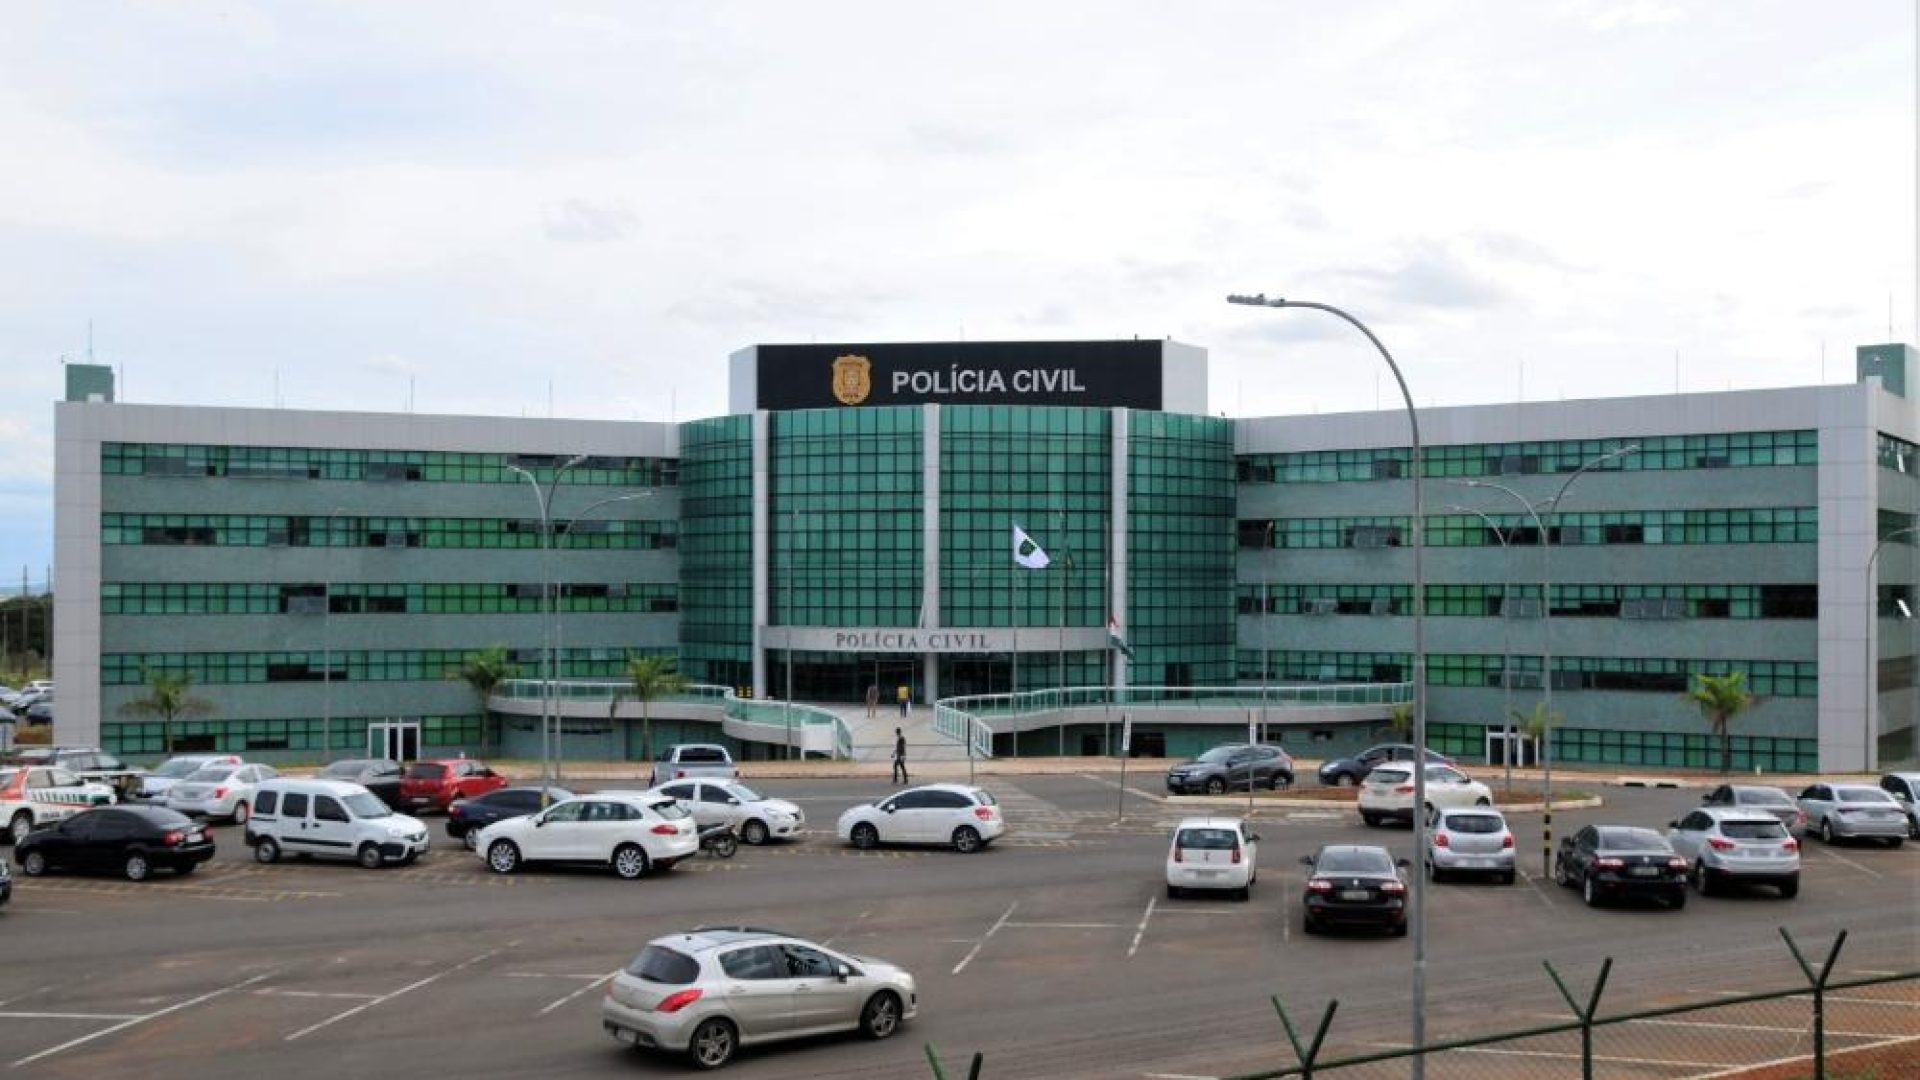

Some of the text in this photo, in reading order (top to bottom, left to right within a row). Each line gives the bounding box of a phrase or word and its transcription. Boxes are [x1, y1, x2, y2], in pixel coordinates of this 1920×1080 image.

[892, 363, 1086, 394] POLÍCIA CIVIL
[836, 631, 990, 649] POLÍCIA CIVIL
